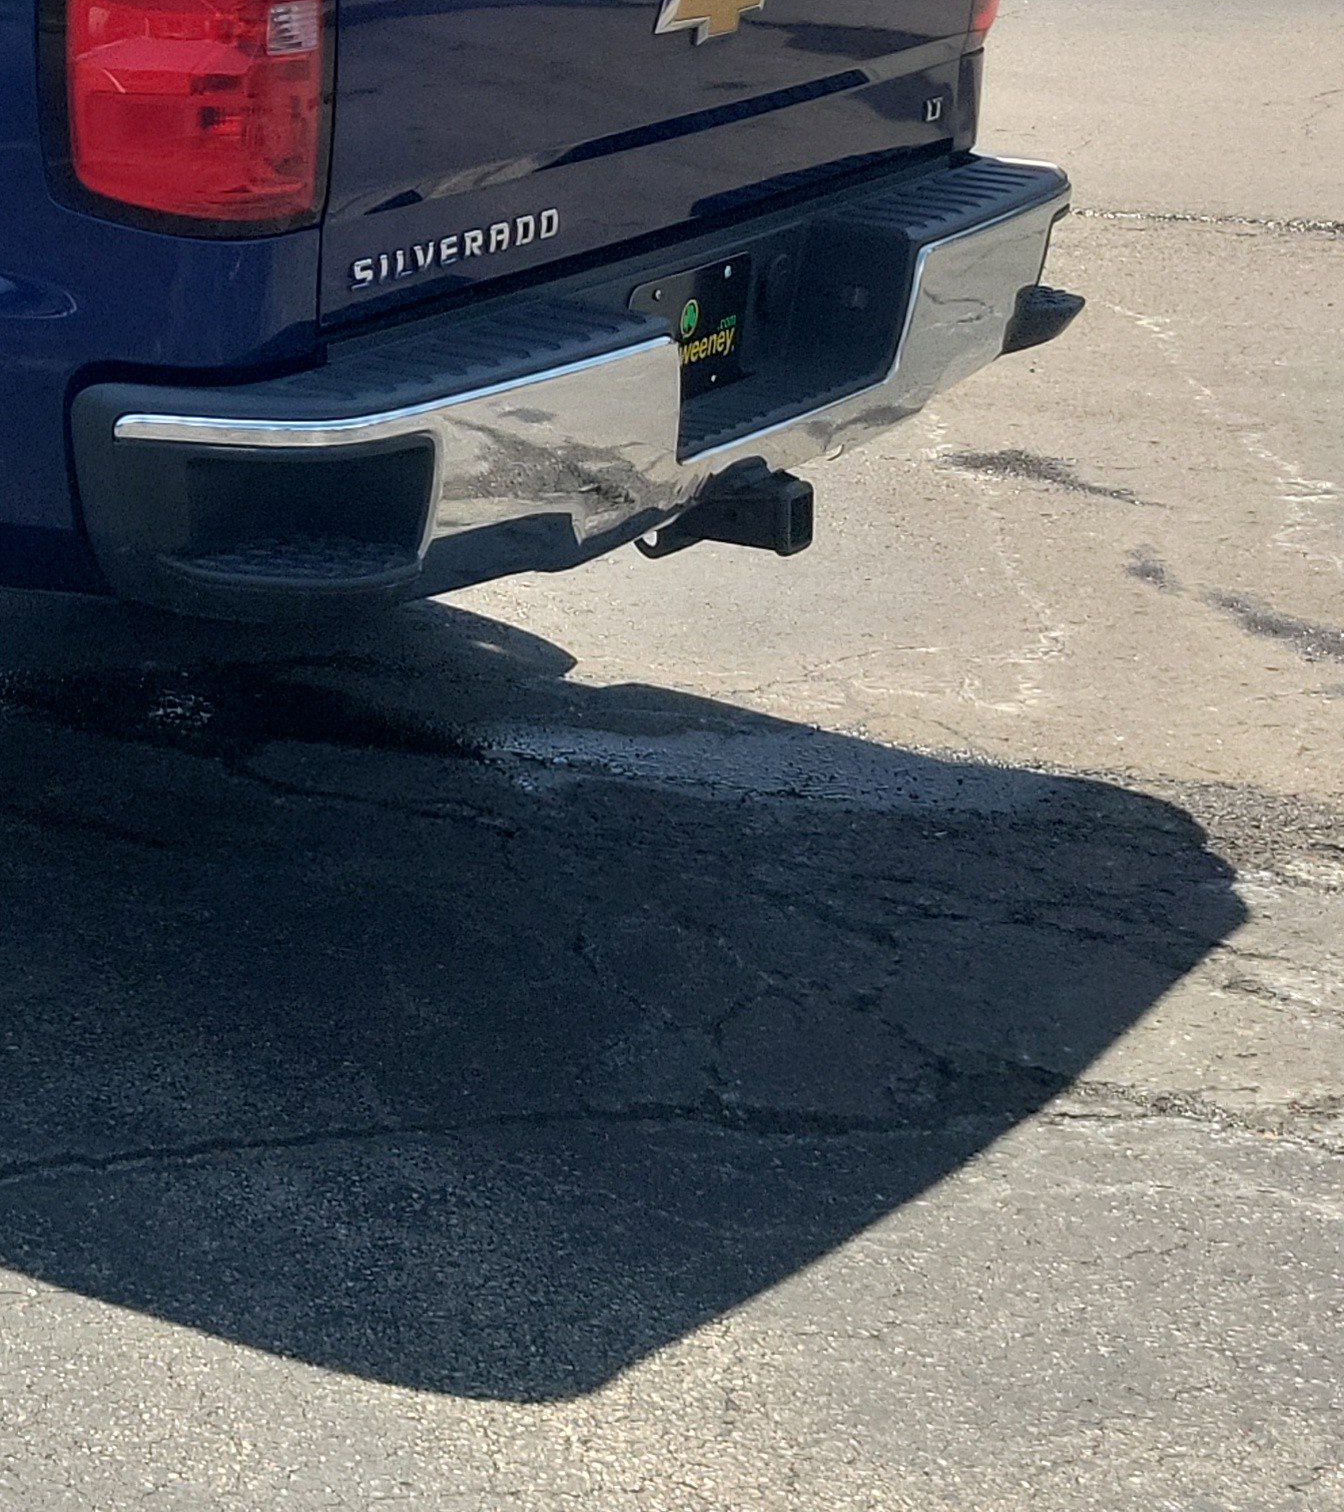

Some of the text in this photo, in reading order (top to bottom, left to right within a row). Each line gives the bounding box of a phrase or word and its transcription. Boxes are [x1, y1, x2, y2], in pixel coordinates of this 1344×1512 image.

[925, 96, 944, 122] LT
[350, 207, 559, 290] SILVERADO
[679, 327, 735, 365] weeney
